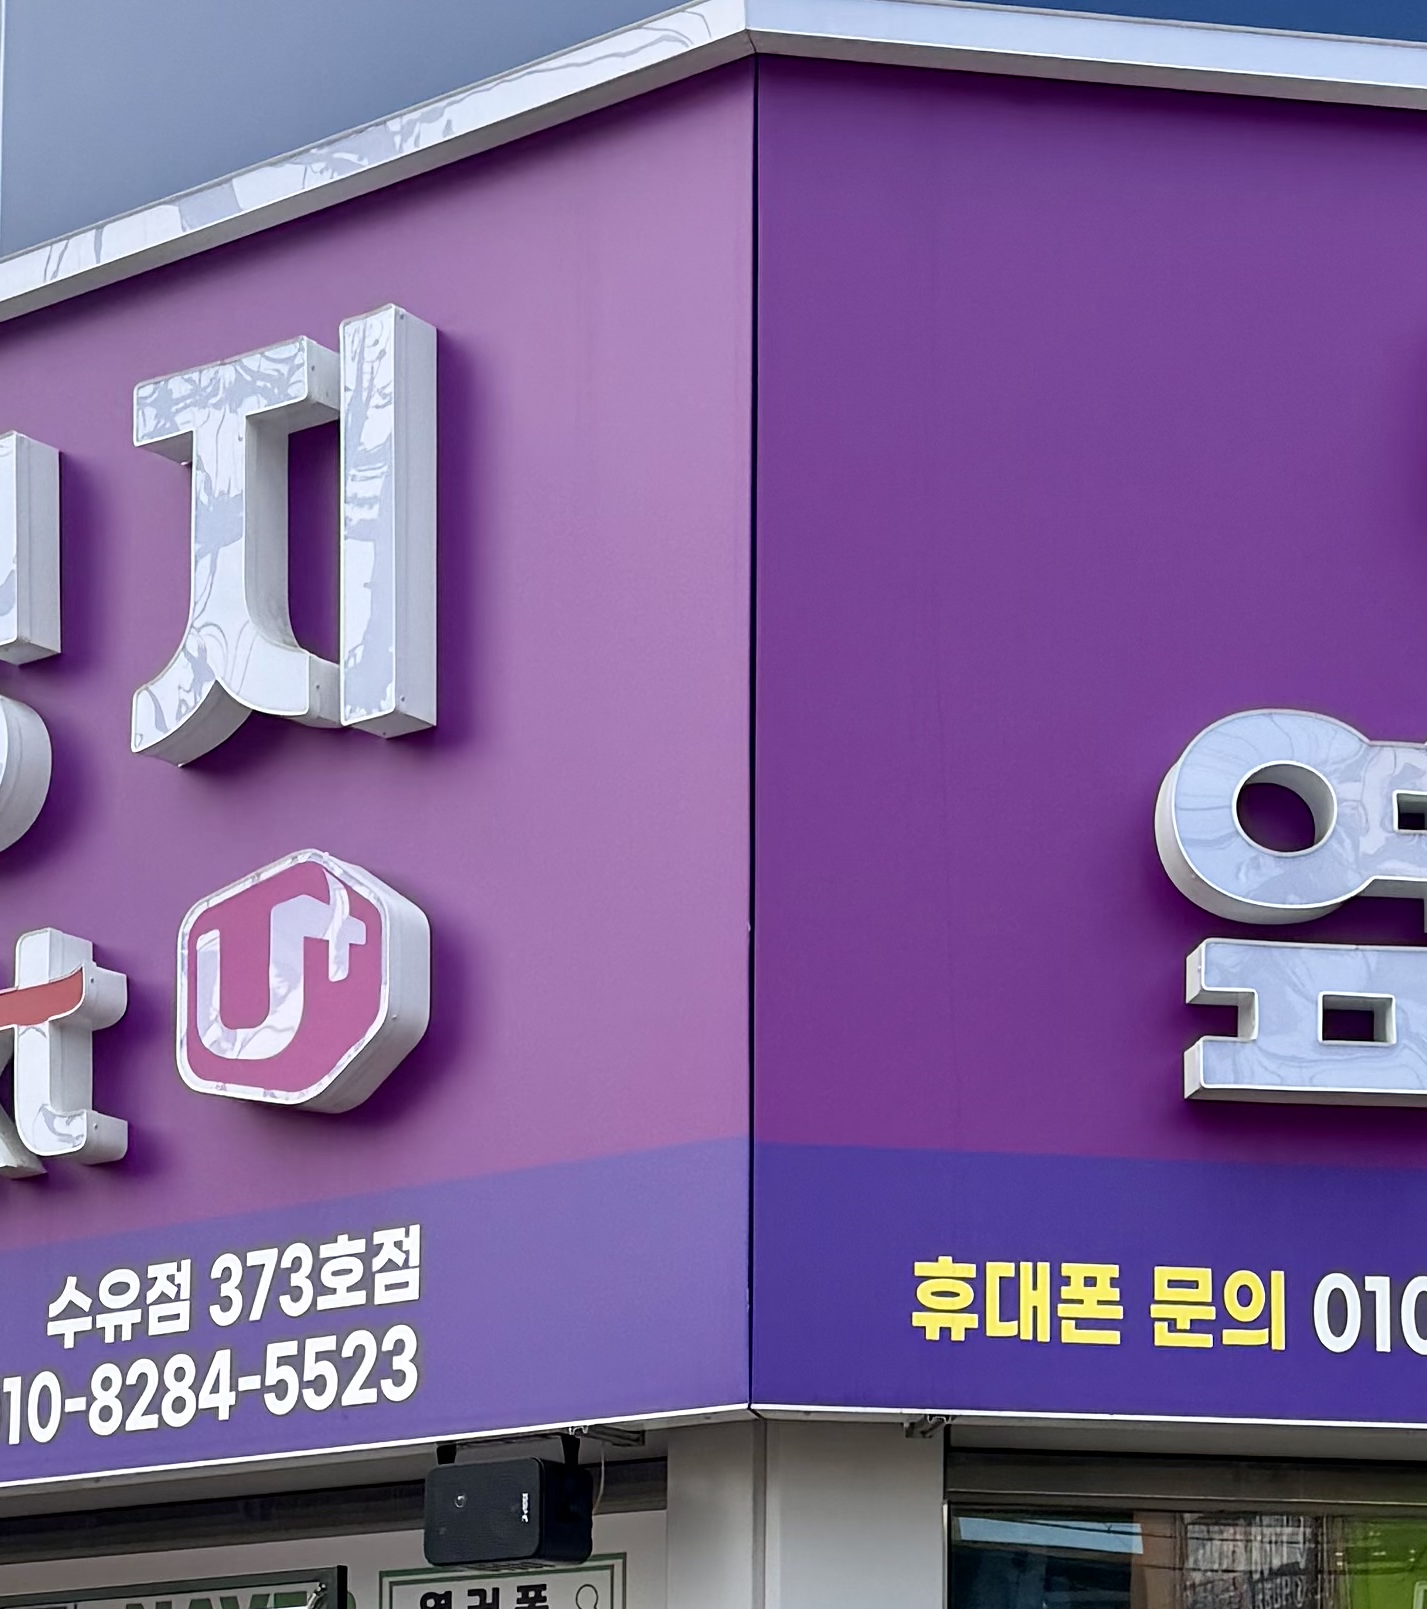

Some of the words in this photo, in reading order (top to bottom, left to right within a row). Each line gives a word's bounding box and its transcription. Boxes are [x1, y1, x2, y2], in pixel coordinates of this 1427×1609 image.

[46, 1257, 192, 1352] 수유점
[209, 1224, 423, 1328] 373호점
[910, 1256, 1128, 1346] 휴대폰
[1148, 1268, 1289, 1355] 문의
